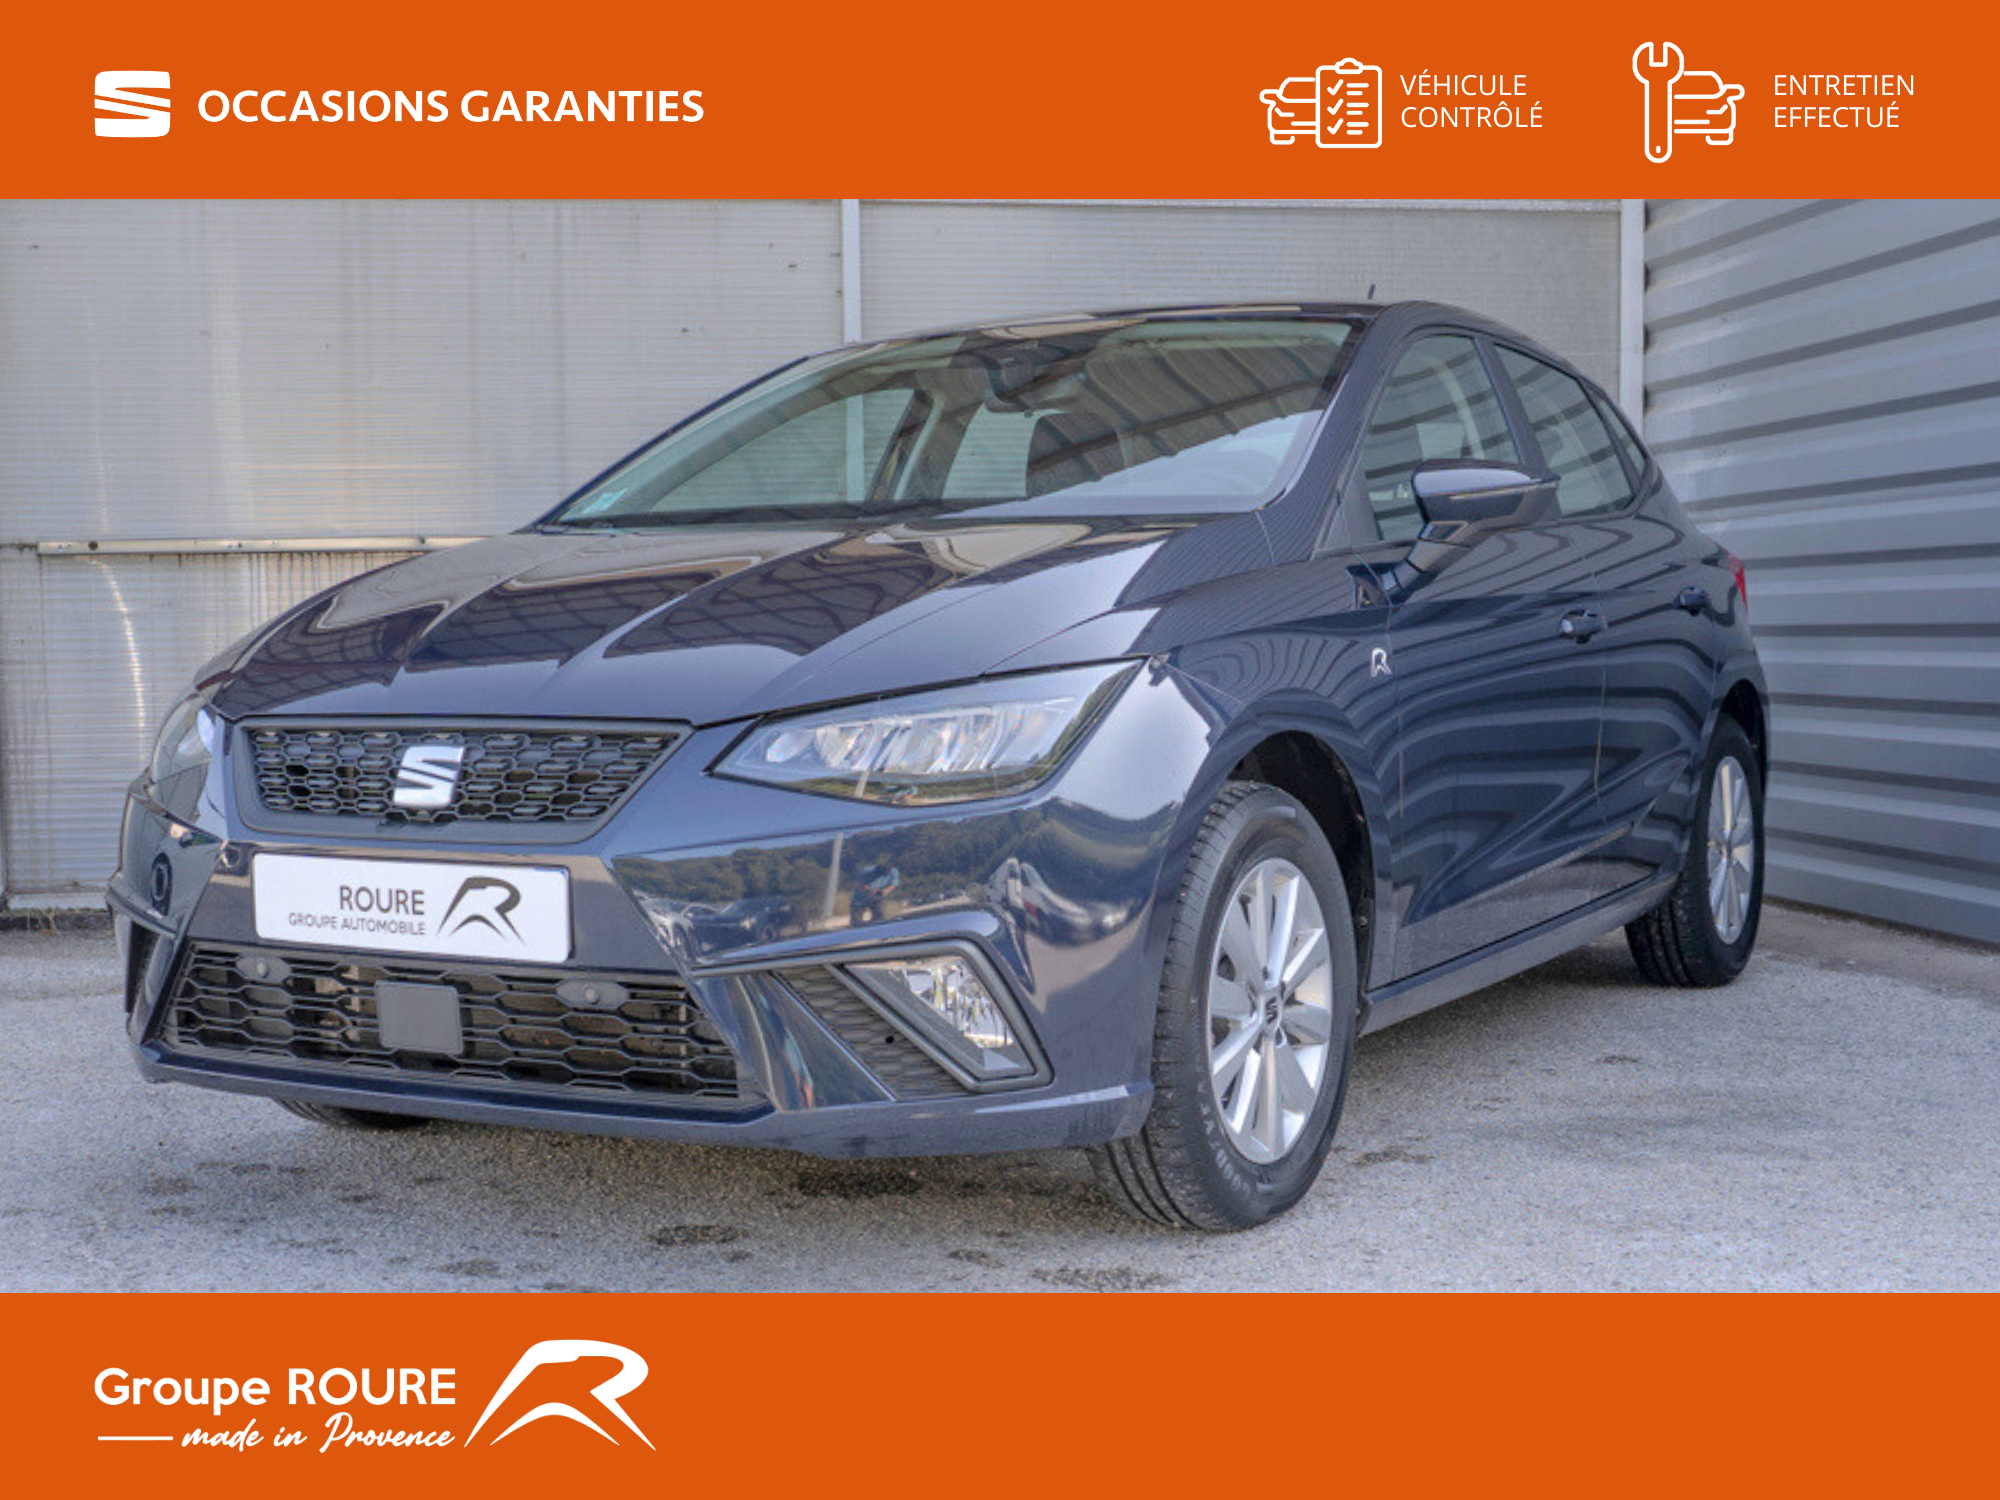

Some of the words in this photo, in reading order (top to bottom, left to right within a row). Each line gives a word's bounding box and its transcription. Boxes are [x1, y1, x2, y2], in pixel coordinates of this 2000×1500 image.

[339, 884, 426, 916] ROURE
[288, 911, 338, 930] GROUPE
[340, 917, 426, 937] AUTOMOBILE
